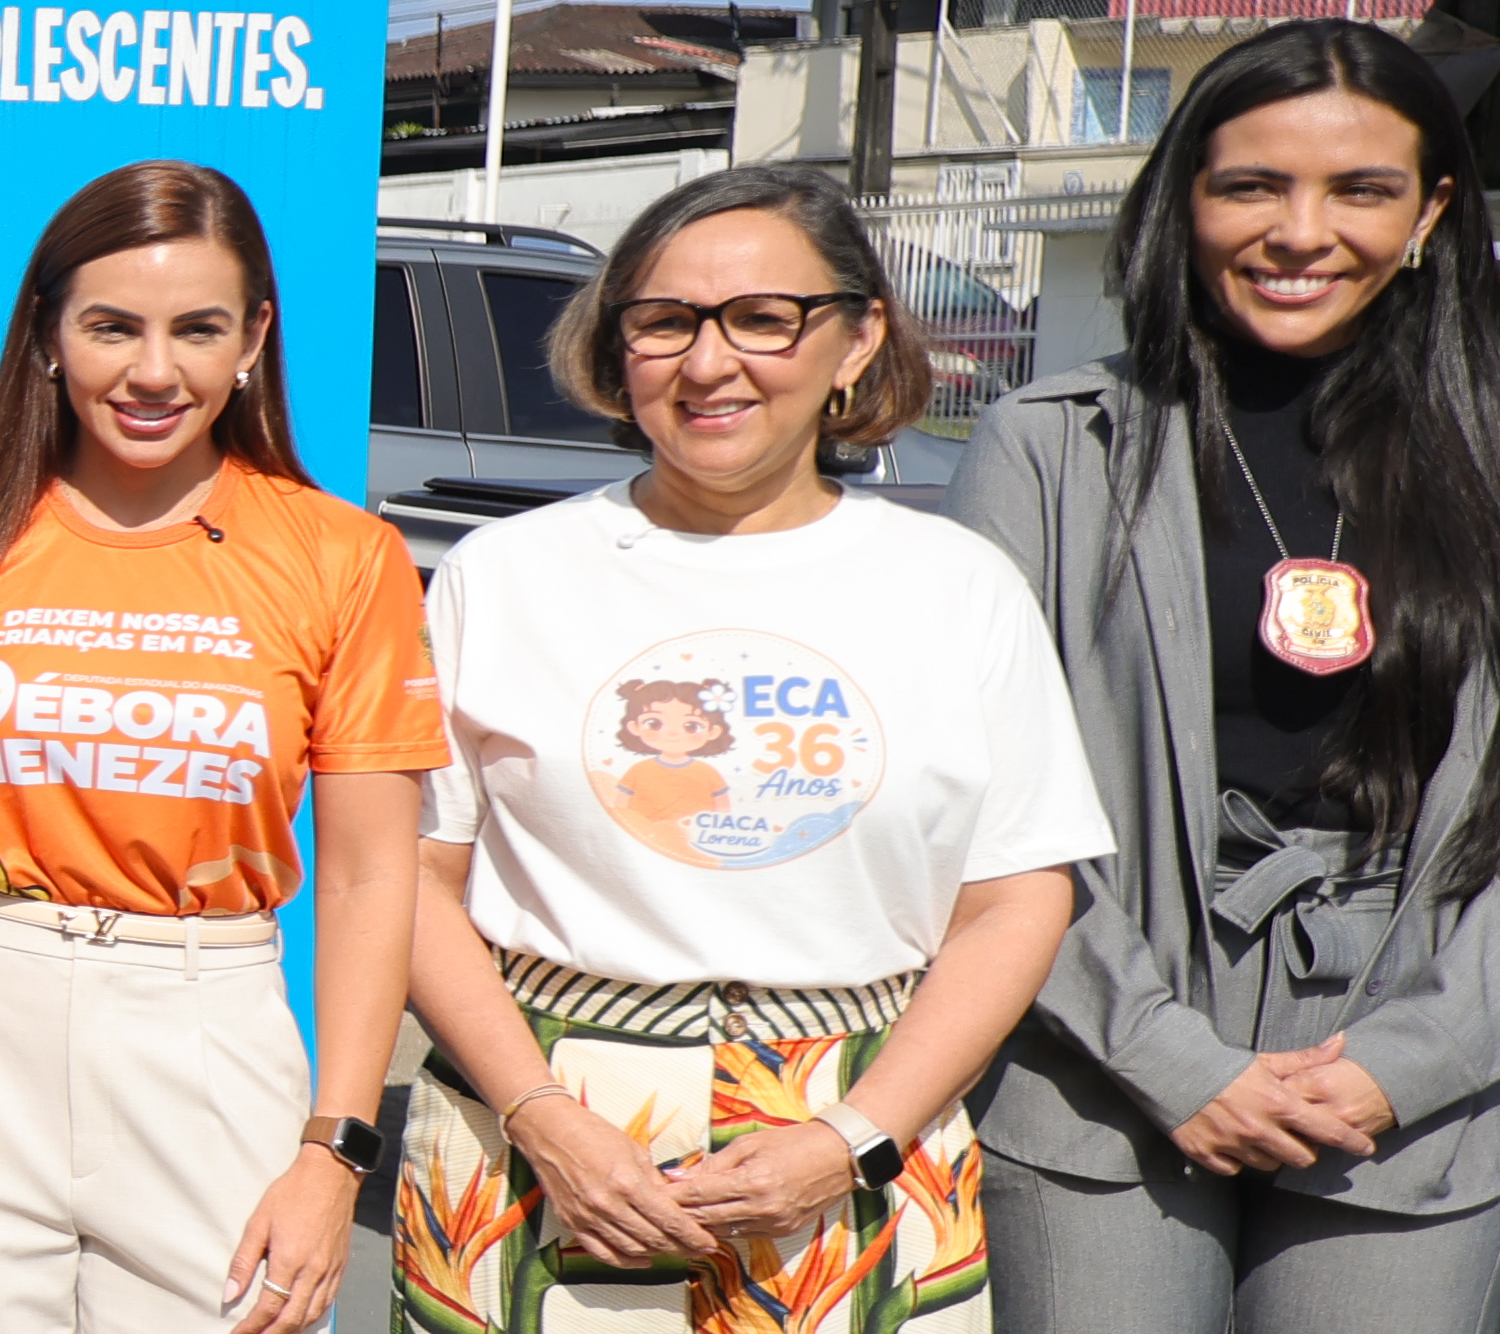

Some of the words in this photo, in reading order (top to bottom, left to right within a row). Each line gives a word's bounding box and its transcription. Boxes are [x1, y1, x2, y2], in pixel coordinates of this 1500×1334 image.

[3, 607, 115, 629] DEIXEM
[120, 612, 240, 636] NOSSAS
[141, 634, 187, 654] EM
[193, 636, 255, 660] PAZ
[62, 673, 123, 685] DEPUTADA
[125, 677, 182, 690] ESTADUAL
[182, 681, 201, 691] DO
[202, 682, 265, 700] AMAZONAS
[742, 675, 850, 719] ECA
[751, 721, 846, 777] 36
[756, 768, 843, 799] Anos
[695, 813, 770, 832] CIACA
[697, 829, 763, 847] Lorena
